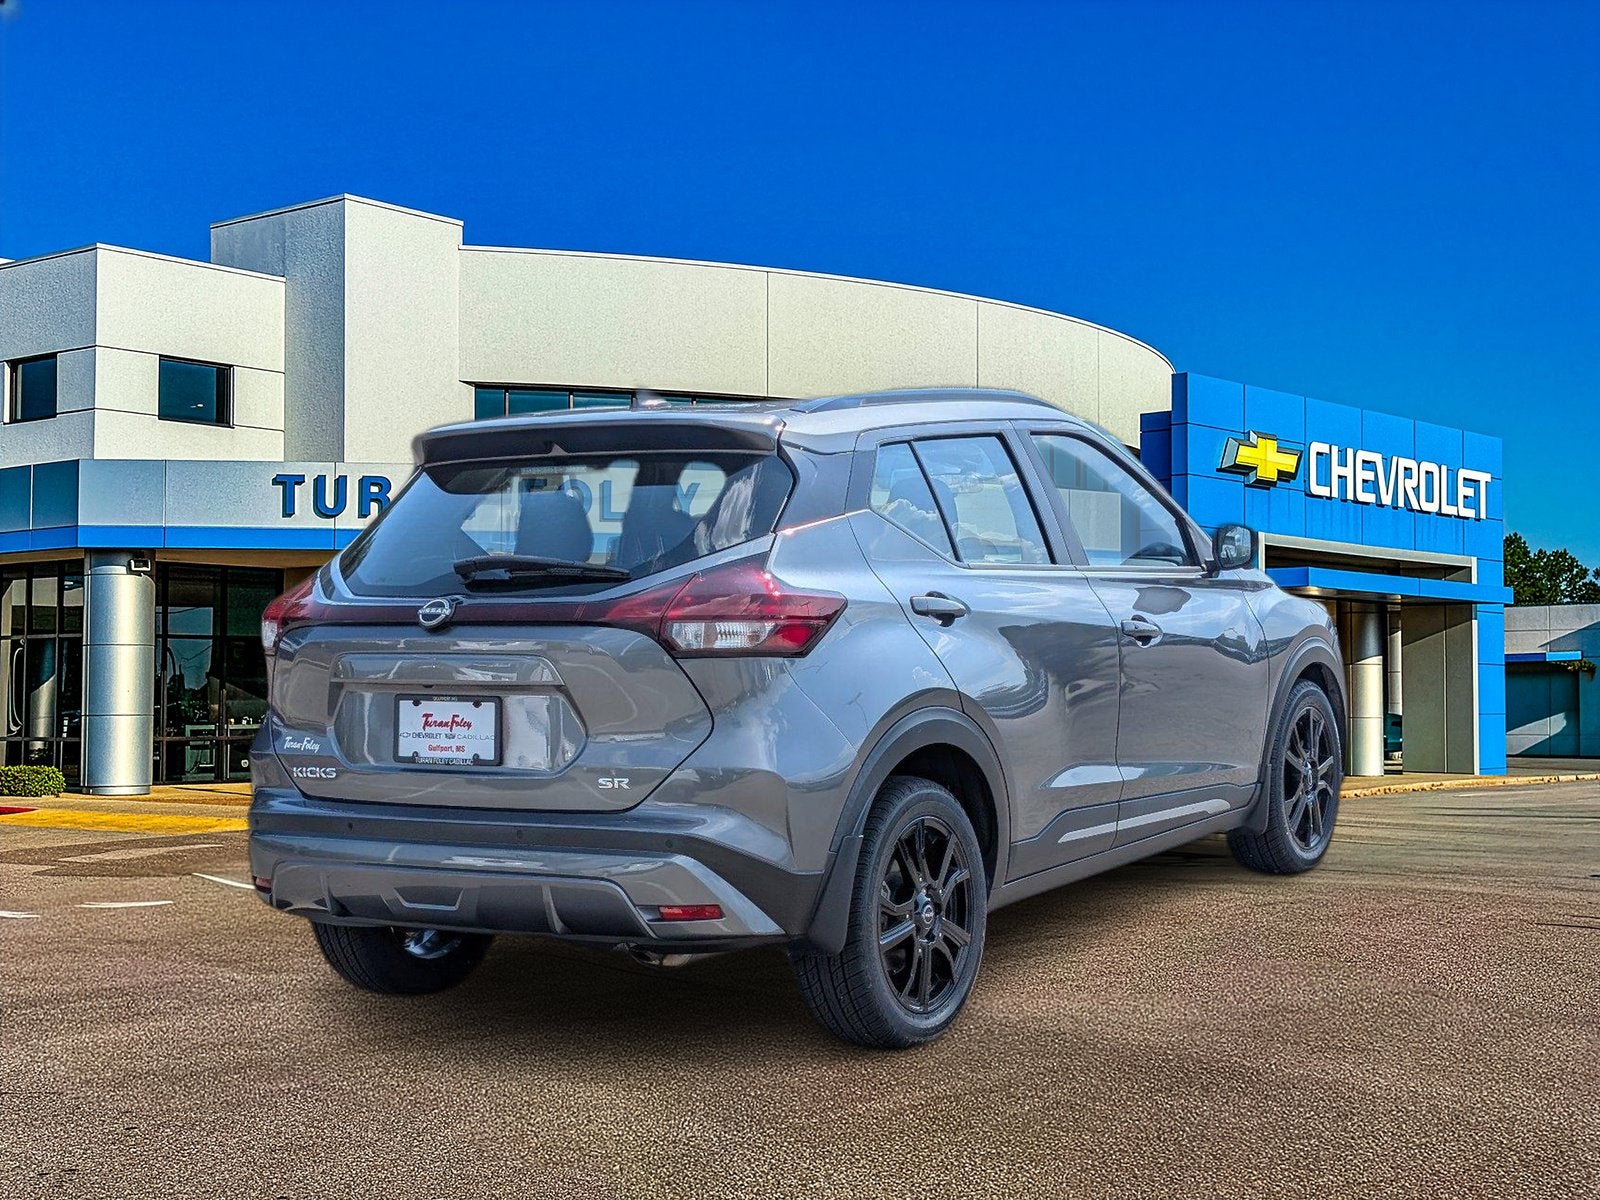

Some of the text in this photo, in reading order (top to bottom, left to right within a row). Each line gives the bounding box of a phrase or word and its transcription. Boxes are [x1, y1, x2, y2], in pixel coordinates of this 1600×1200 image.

[1308, 441, 1492, 520] CHEVROLET
[417, 606, 451, 616] NISSAN
[411, 731, 496, 741] CHEVROLET CADILLAC
[455, 745, 466, 753] MS
[293, 766, 337, 779] KICKS
[598, 777, 631, 790] SR
